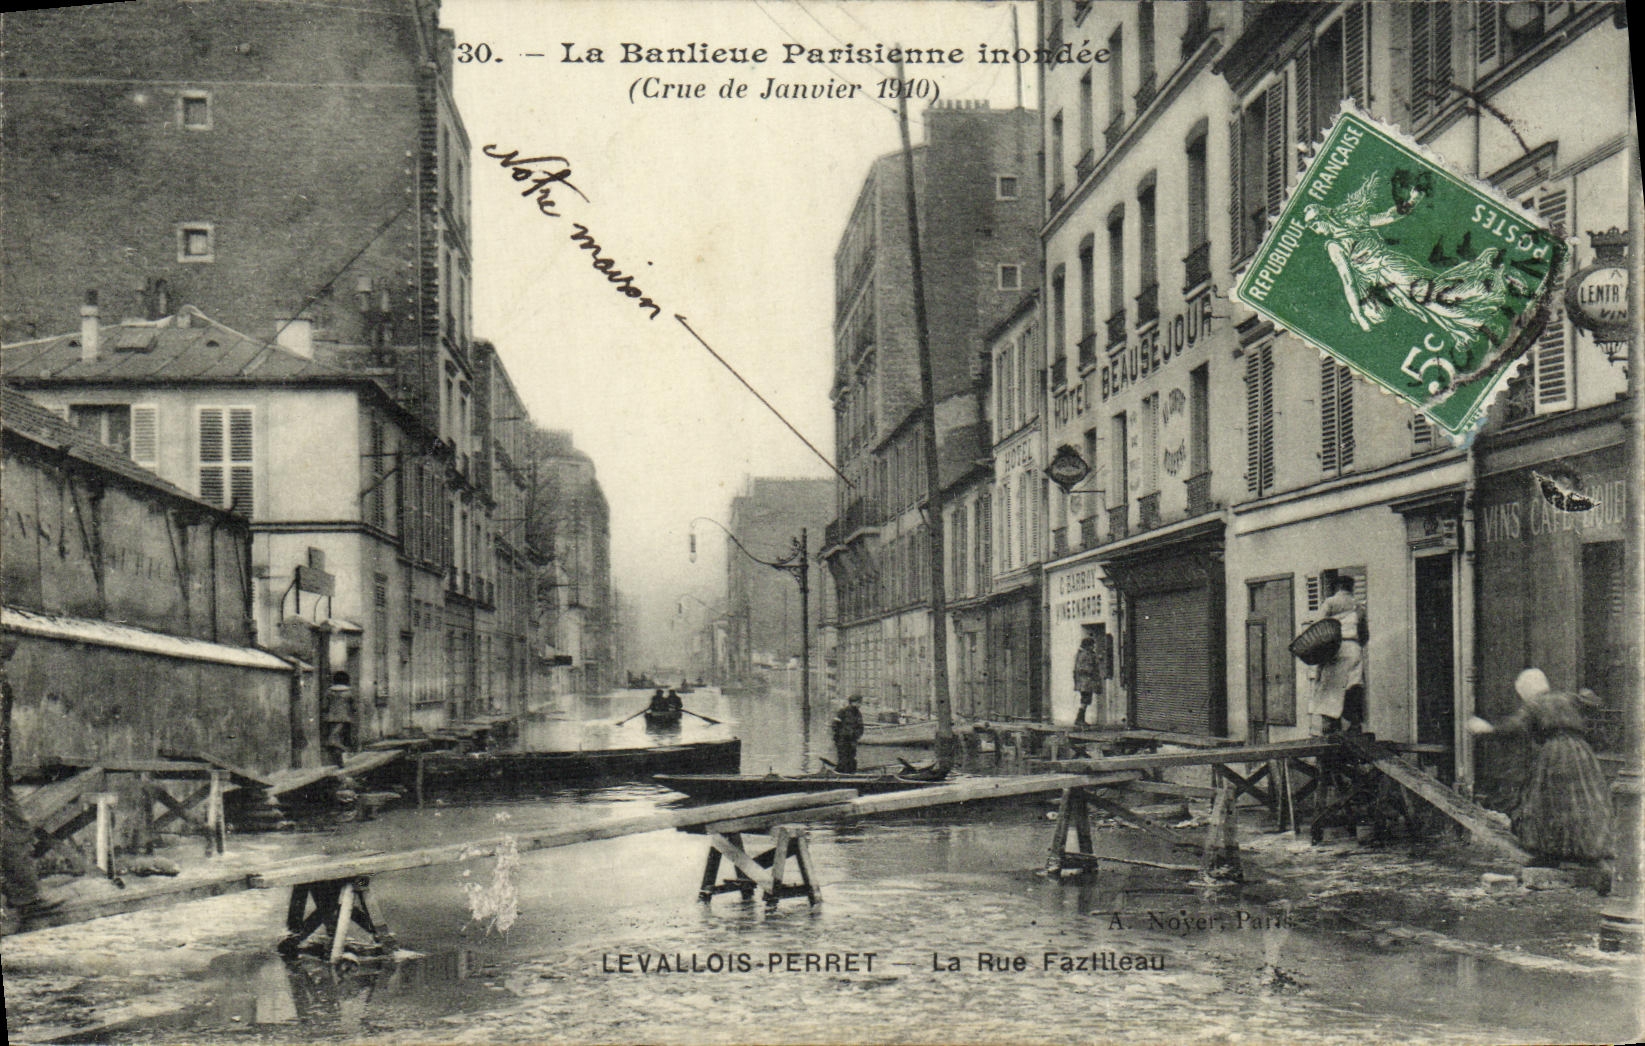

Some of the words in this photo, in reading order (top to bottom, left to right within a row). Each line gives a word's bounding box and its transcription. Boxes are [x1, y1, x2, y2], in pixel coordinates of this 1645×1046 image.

[1307, 126, 1364, 200] FRANÇAISE
[482, 144, 590, 218] Notre
[570, 223, 661, 319] maison
[1471, 204, 1550, 259] POSTES
[1483, 502, 1520, 543] VINS
